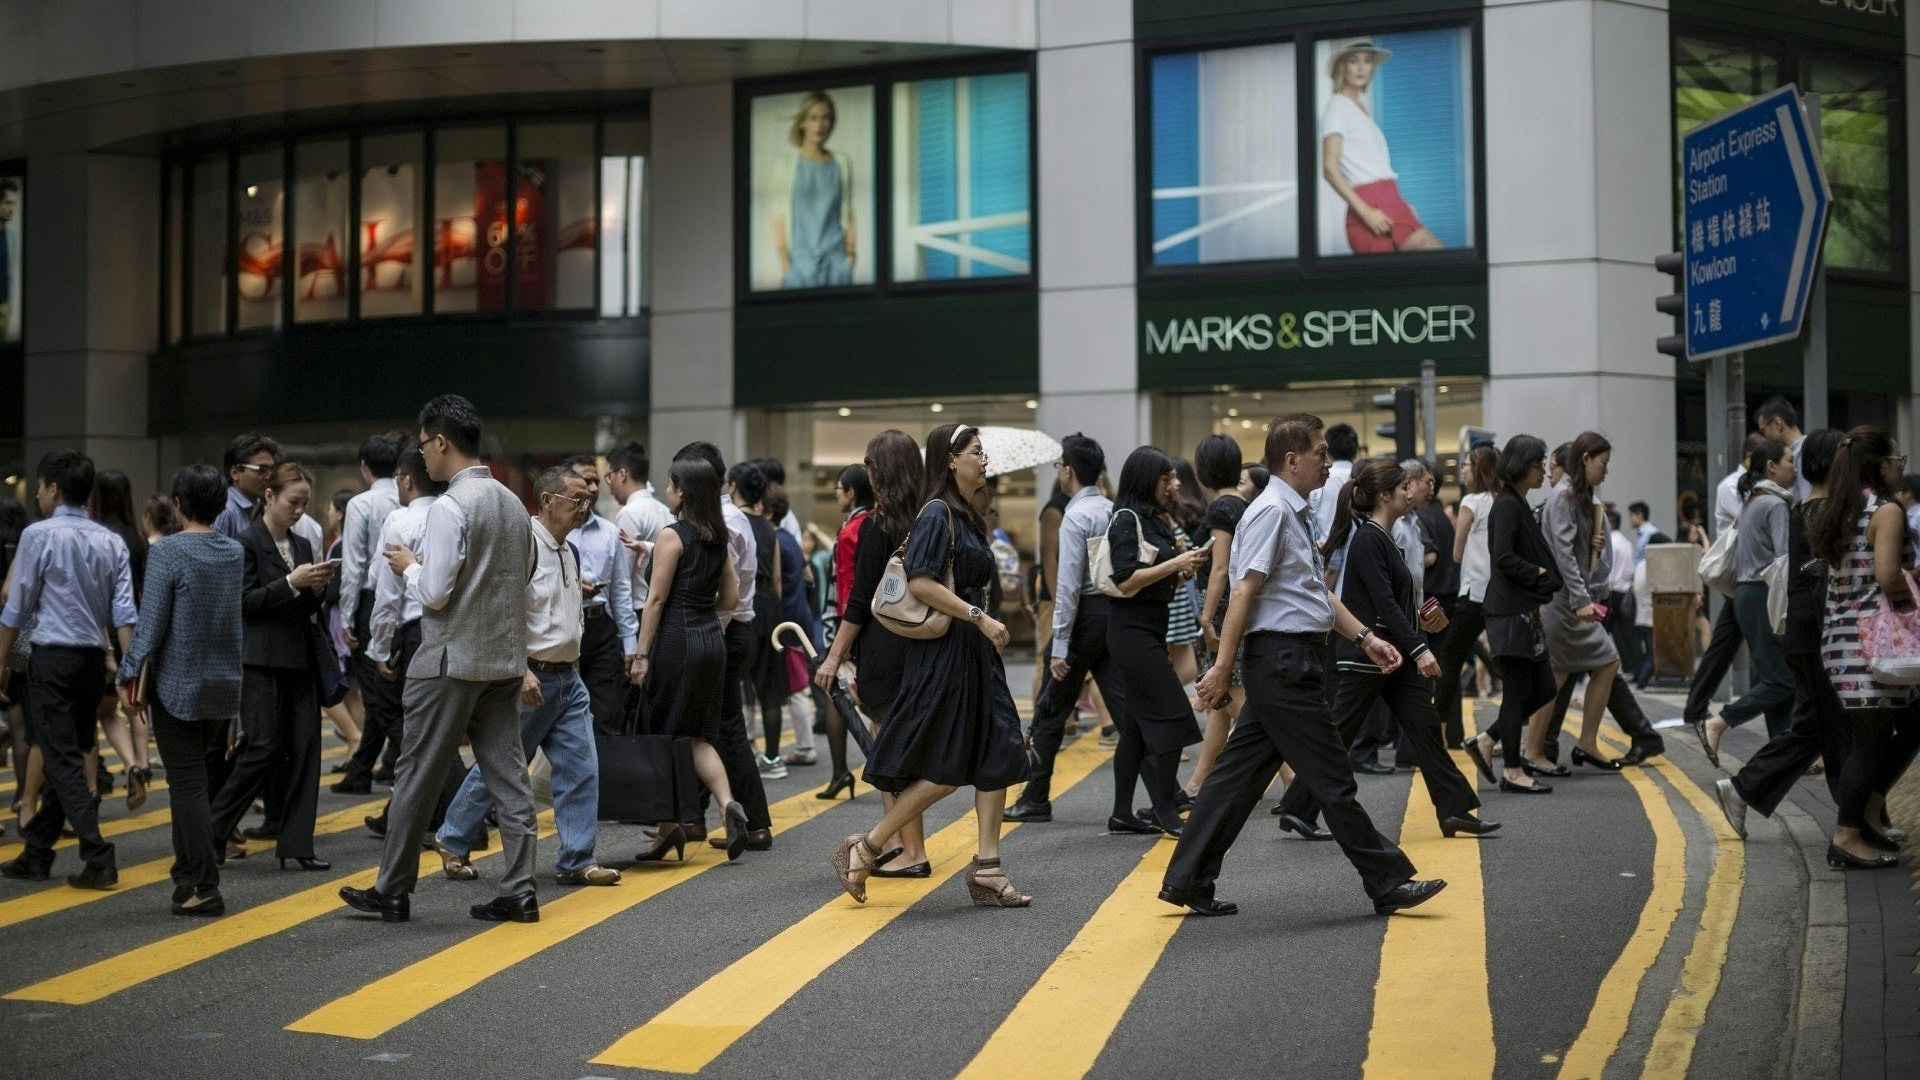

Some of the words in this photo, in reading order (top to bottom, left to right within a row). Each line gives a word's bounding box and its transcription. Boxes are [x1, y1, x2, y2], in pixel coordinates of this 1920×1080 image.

[1689, 138, 1726, 175] Airport
[1728, 120, 1777, 159] Express
[1689, 174, 1728, 204] Station
[1691, 255, 1737, 286] Kowloon
[1693, 298, 1723, 336] 九龍
